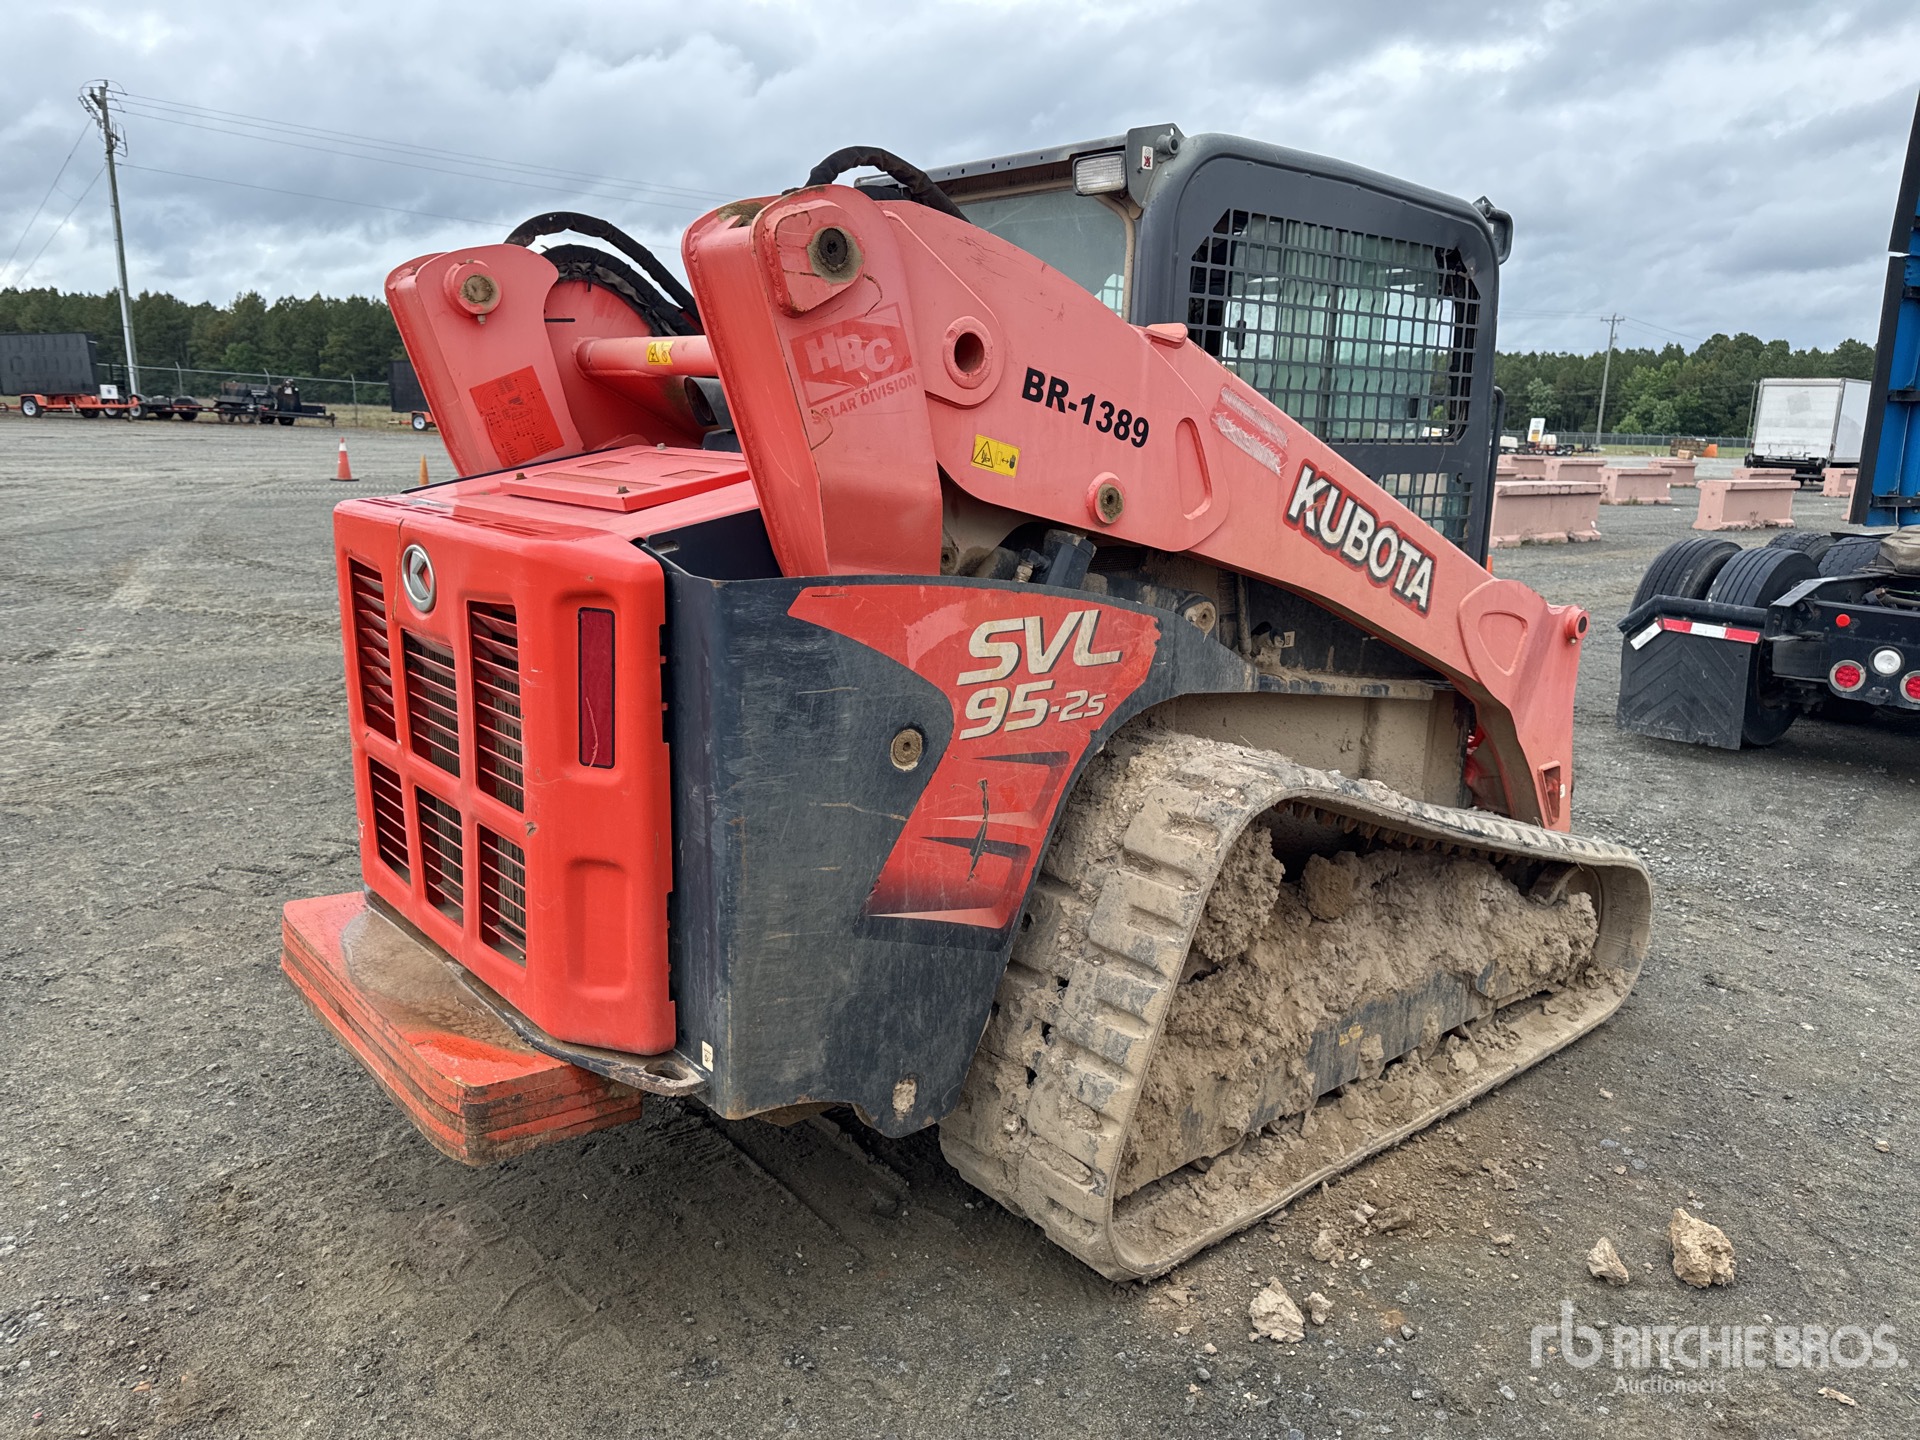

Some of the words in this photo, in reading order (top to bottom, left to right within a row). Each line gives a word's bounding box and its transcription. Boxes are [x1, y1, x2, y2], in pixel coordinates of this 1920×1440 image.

[804, 332, 895, 375] HBC
[811, 400, 857, 425] SOLAR
[860, 373, 918, 406] DIVISION
[1022, 366, 1150, 448] BR-1389
[1287, 465, 1434, 609] KUBOTA
[956, 609, 1124, 686] SVL
